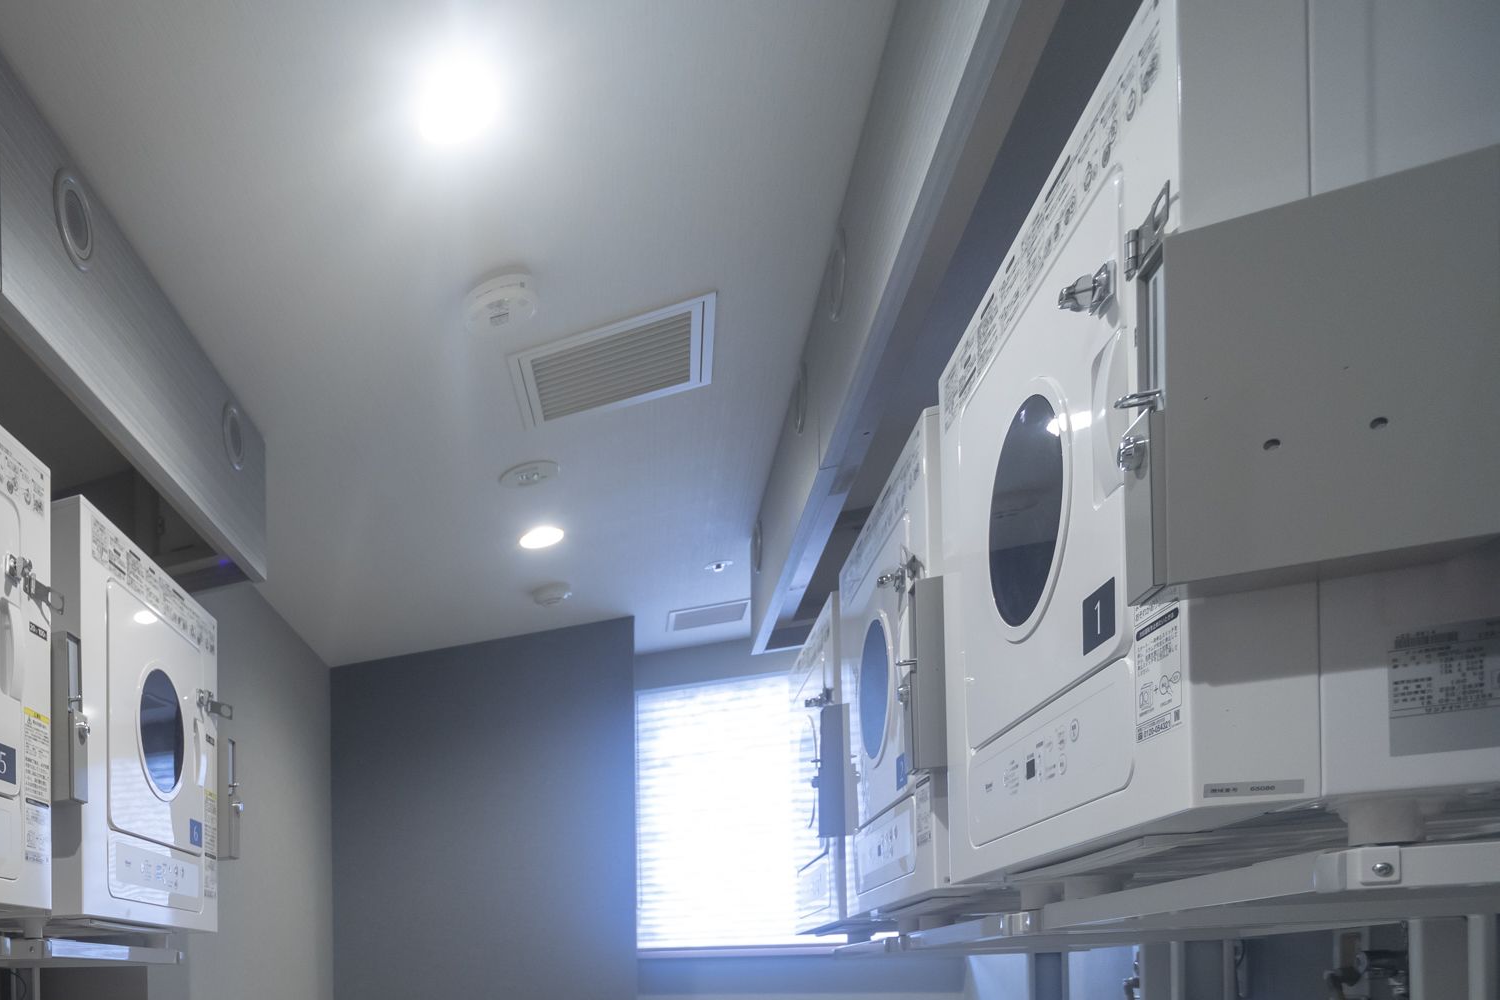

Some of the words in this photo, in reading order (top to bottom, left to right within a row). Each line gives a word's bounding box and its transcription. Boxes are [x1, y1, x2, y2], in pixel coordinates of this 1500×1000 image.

[1094, 600, 1101, 634] 1
[0, 751, 7, 774] 5
[192, 828, 199, 841] 6
